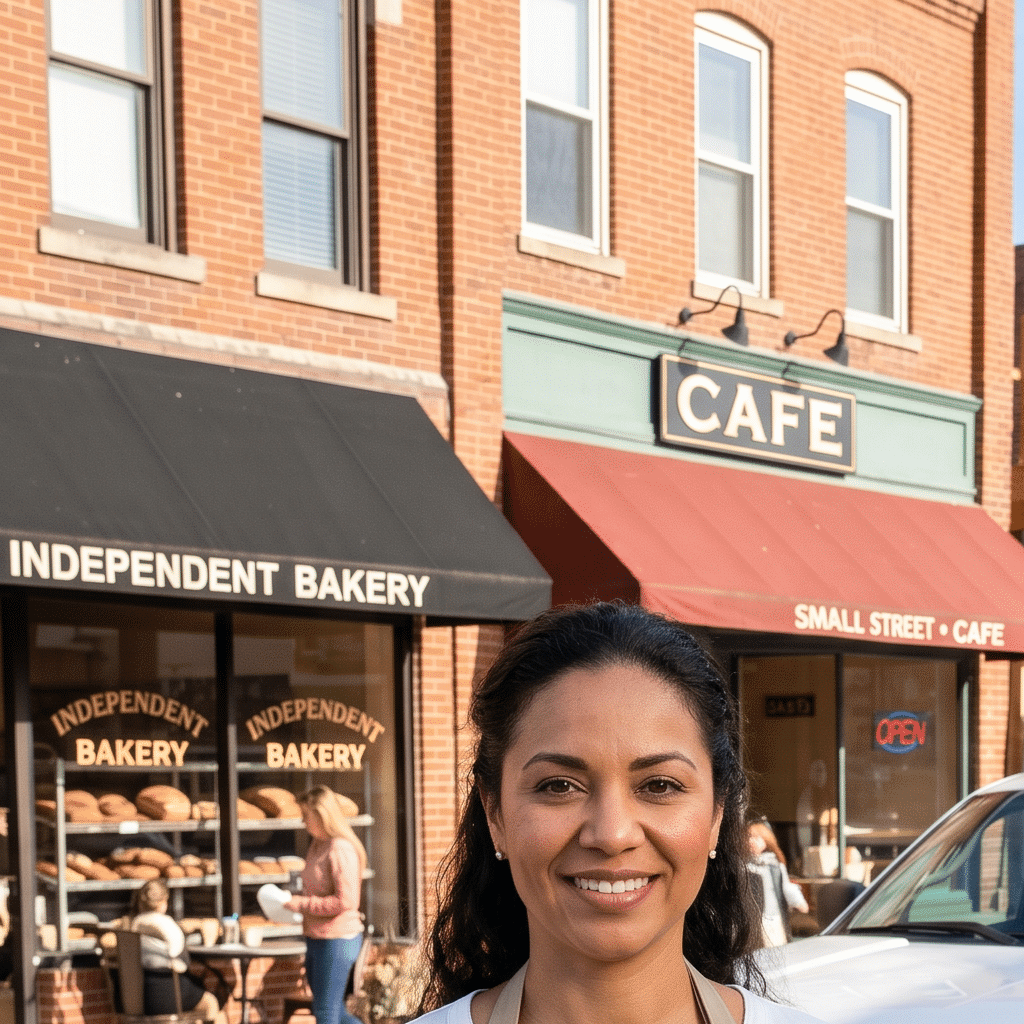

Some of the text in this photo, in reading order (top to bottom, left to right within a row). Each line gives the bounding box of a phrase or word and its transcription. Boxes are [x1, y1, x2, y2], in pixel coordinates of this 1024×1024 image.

[677, 373, 843, 457] CAFE
[9, 540, 430, 607] INDEPENDENT BAKERY
[794, 603, 1005, 646] SMALL STREET CAFE
[50, 690, 209, 738] INDEPENDENT
[246, 698, 385, 743] INDEPENDENT
[875, 718, 927, 745] OPEN
[76, 738, 189, 767] BAKERY
[266, 741, 365, 771] BAKERY
